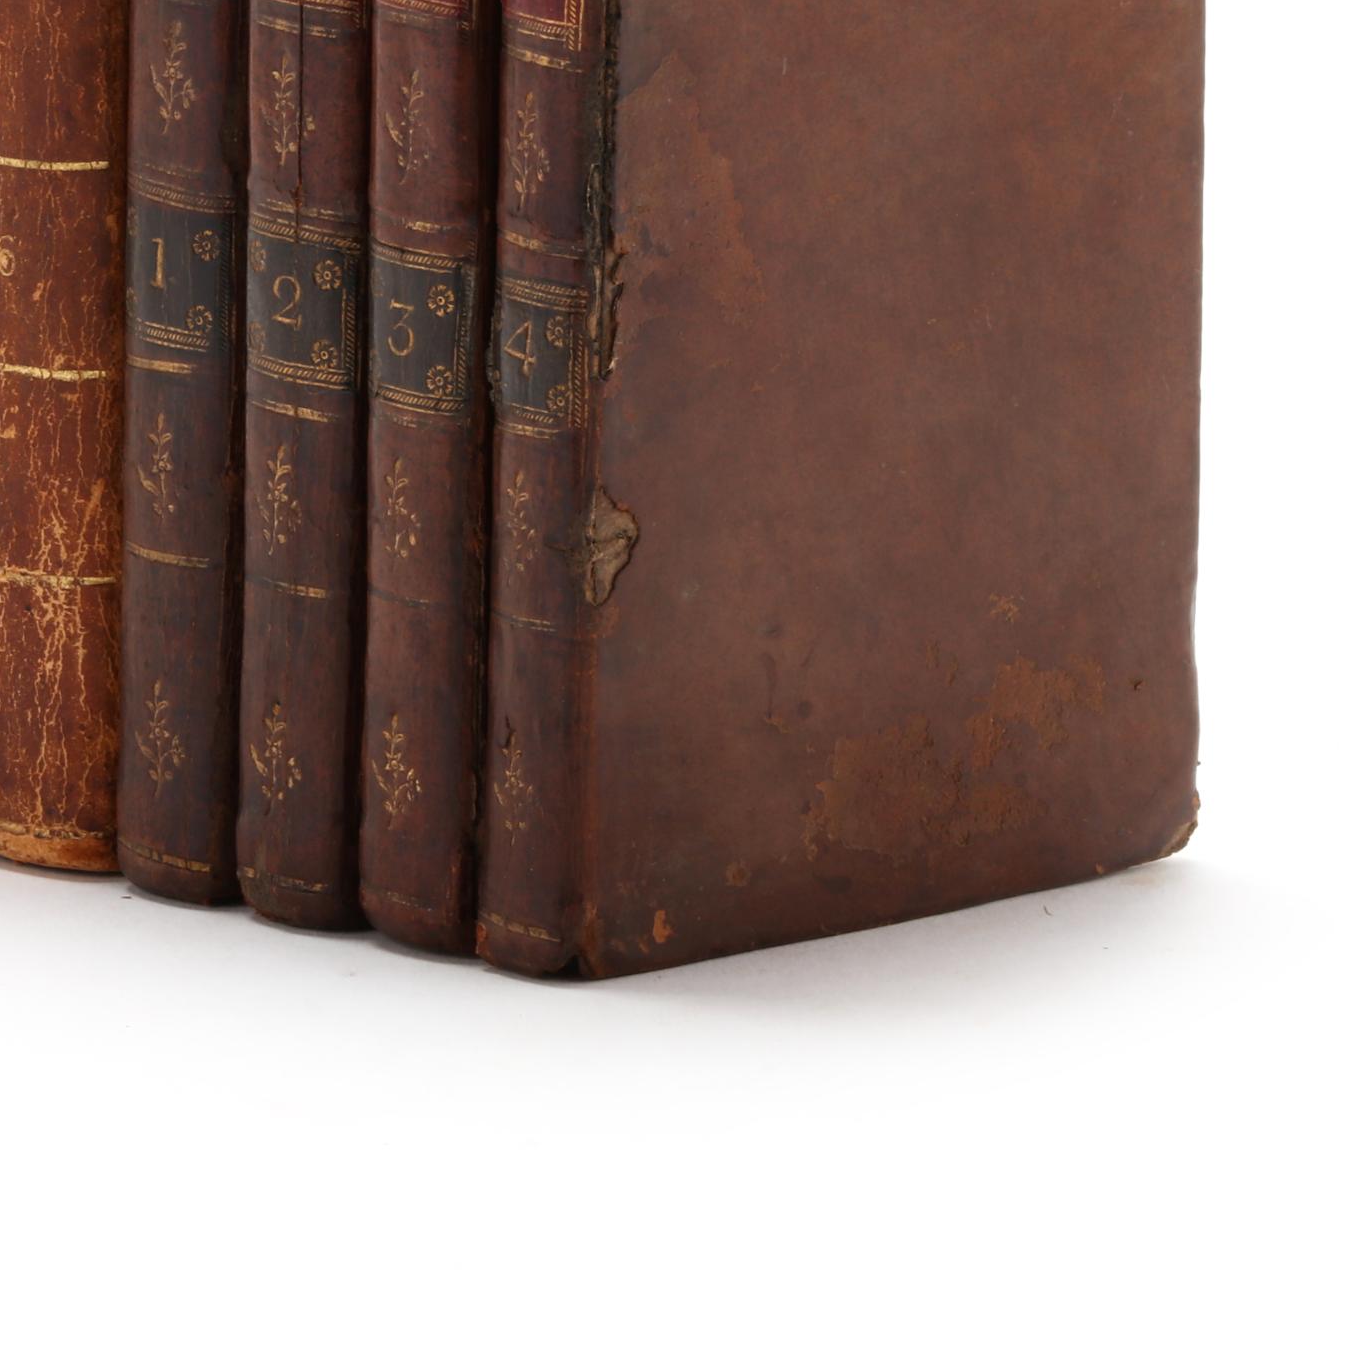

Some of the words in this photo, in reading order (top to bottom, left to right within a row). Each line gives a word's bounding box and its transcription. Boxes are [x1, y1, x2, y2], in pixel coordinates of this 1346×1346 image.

[151, 237, 165, 289] 1
[272, 275, 302, 331] 2
[387, 298, 414, 356] 3
[504, 321, 536, 377] 4
